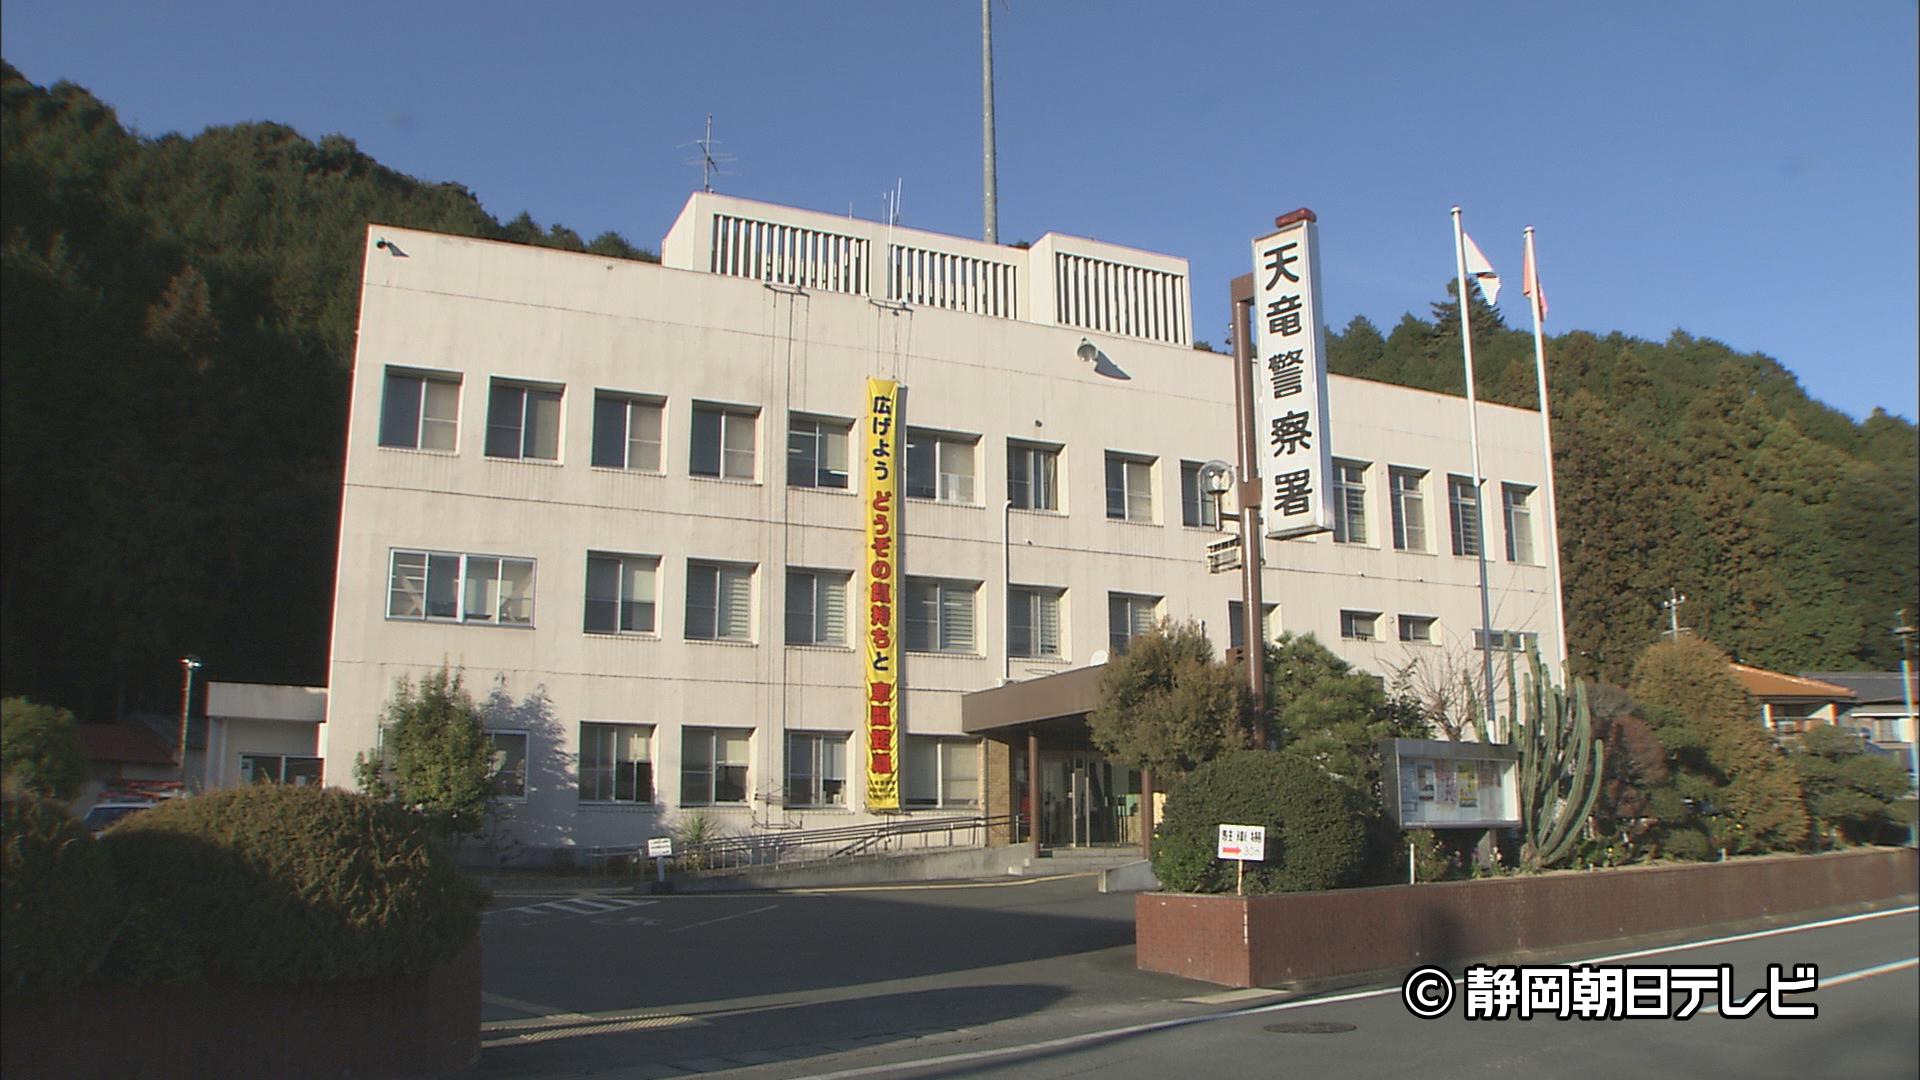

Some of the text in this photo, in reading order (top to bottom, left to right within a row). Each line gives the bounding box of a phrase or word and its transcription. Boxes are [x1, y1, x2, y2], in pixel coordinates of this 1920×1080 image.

[872, 395, 892, 481] 広げよう
[1263, 242, 1313, 517] 天竜警察署
